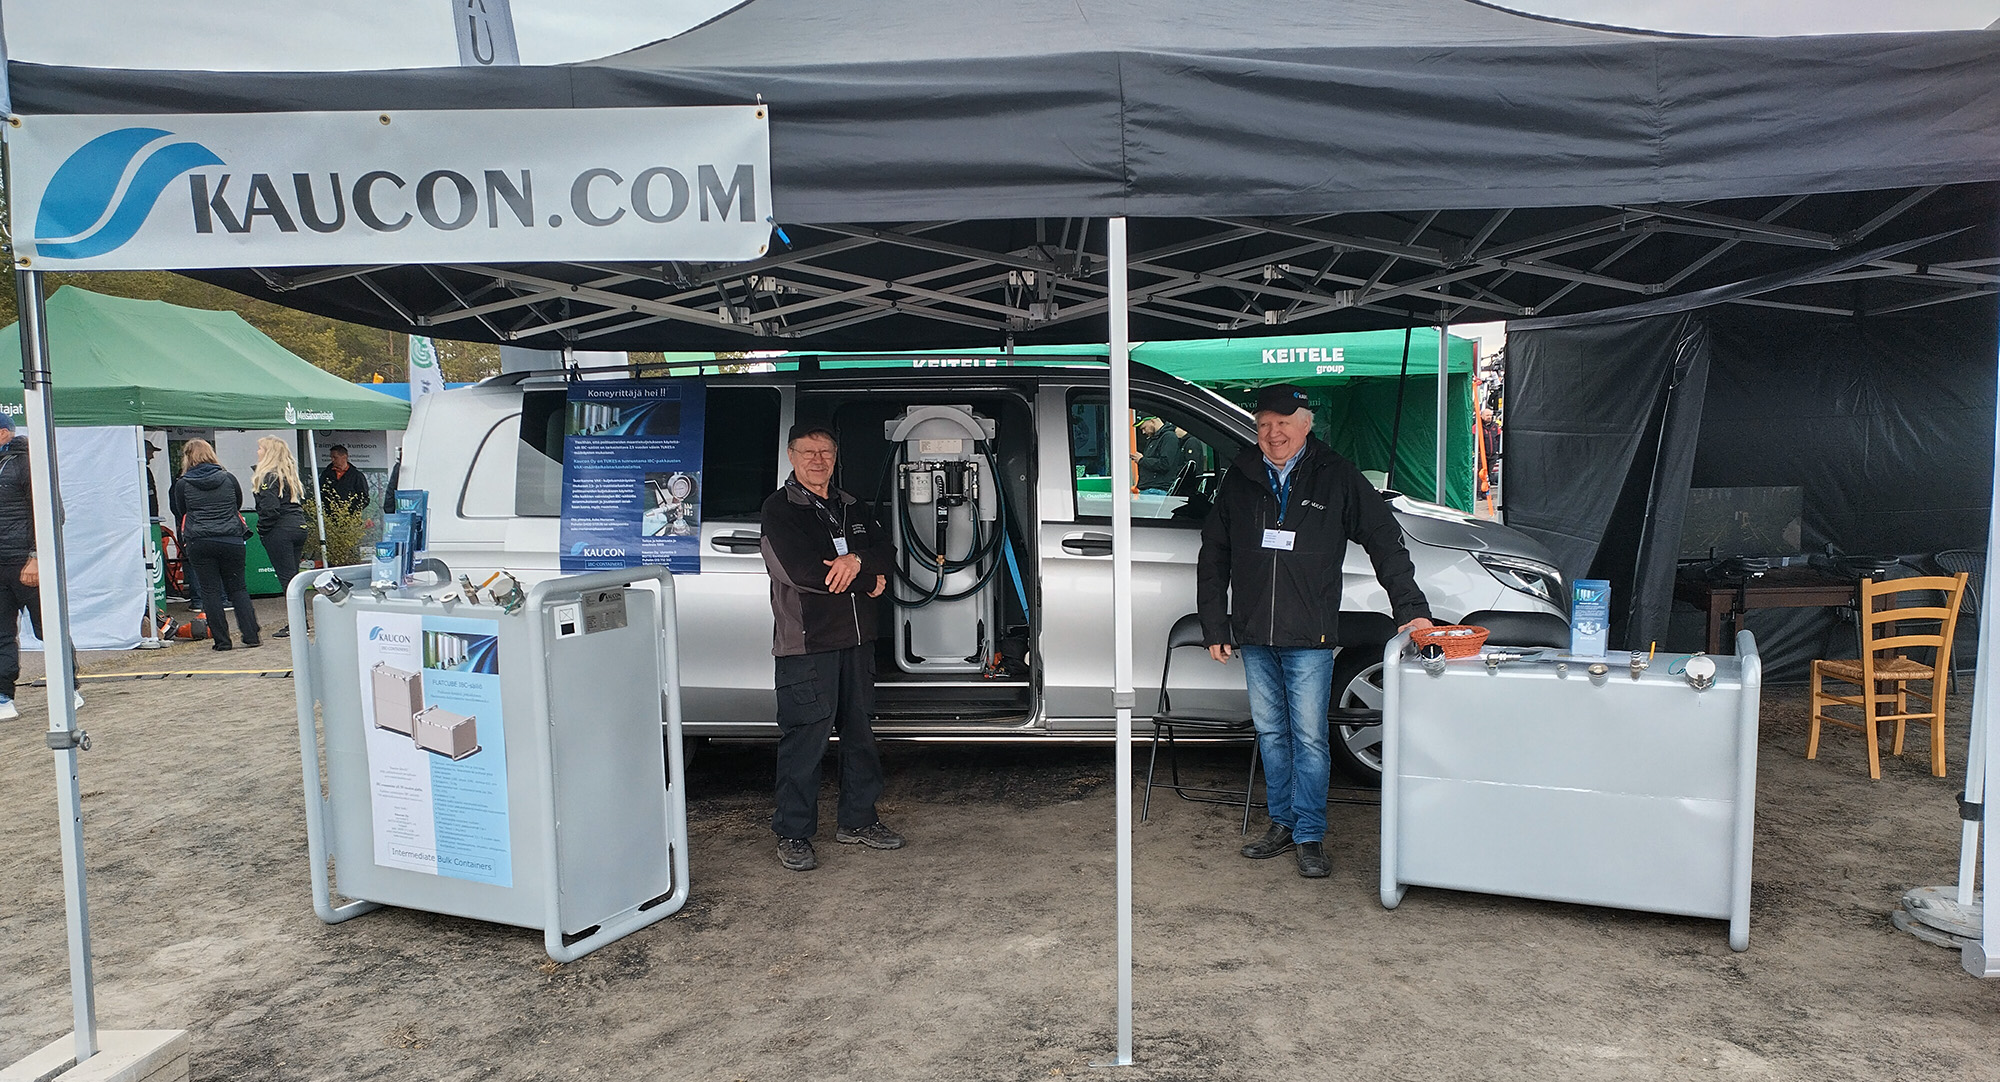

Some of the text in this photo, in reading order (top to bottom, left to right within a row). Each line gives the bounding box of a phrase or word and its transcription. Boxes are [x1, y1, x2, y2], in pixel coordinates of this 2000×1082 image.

[188, 163, 757, 236] KAUCON.COM
[1262, 347, 1345, 364] KEITELE
[1316, 365, 1345, 375] group
[587, 389, 642, 399] Koneyrittäjä
[644, 389, 658, 397] hei
[583, 548, 626, 558] KAUCON
[379, 634, 411, 644] KAUCON
[391, 847, 493, 871] Intermediate Bulk Containers
